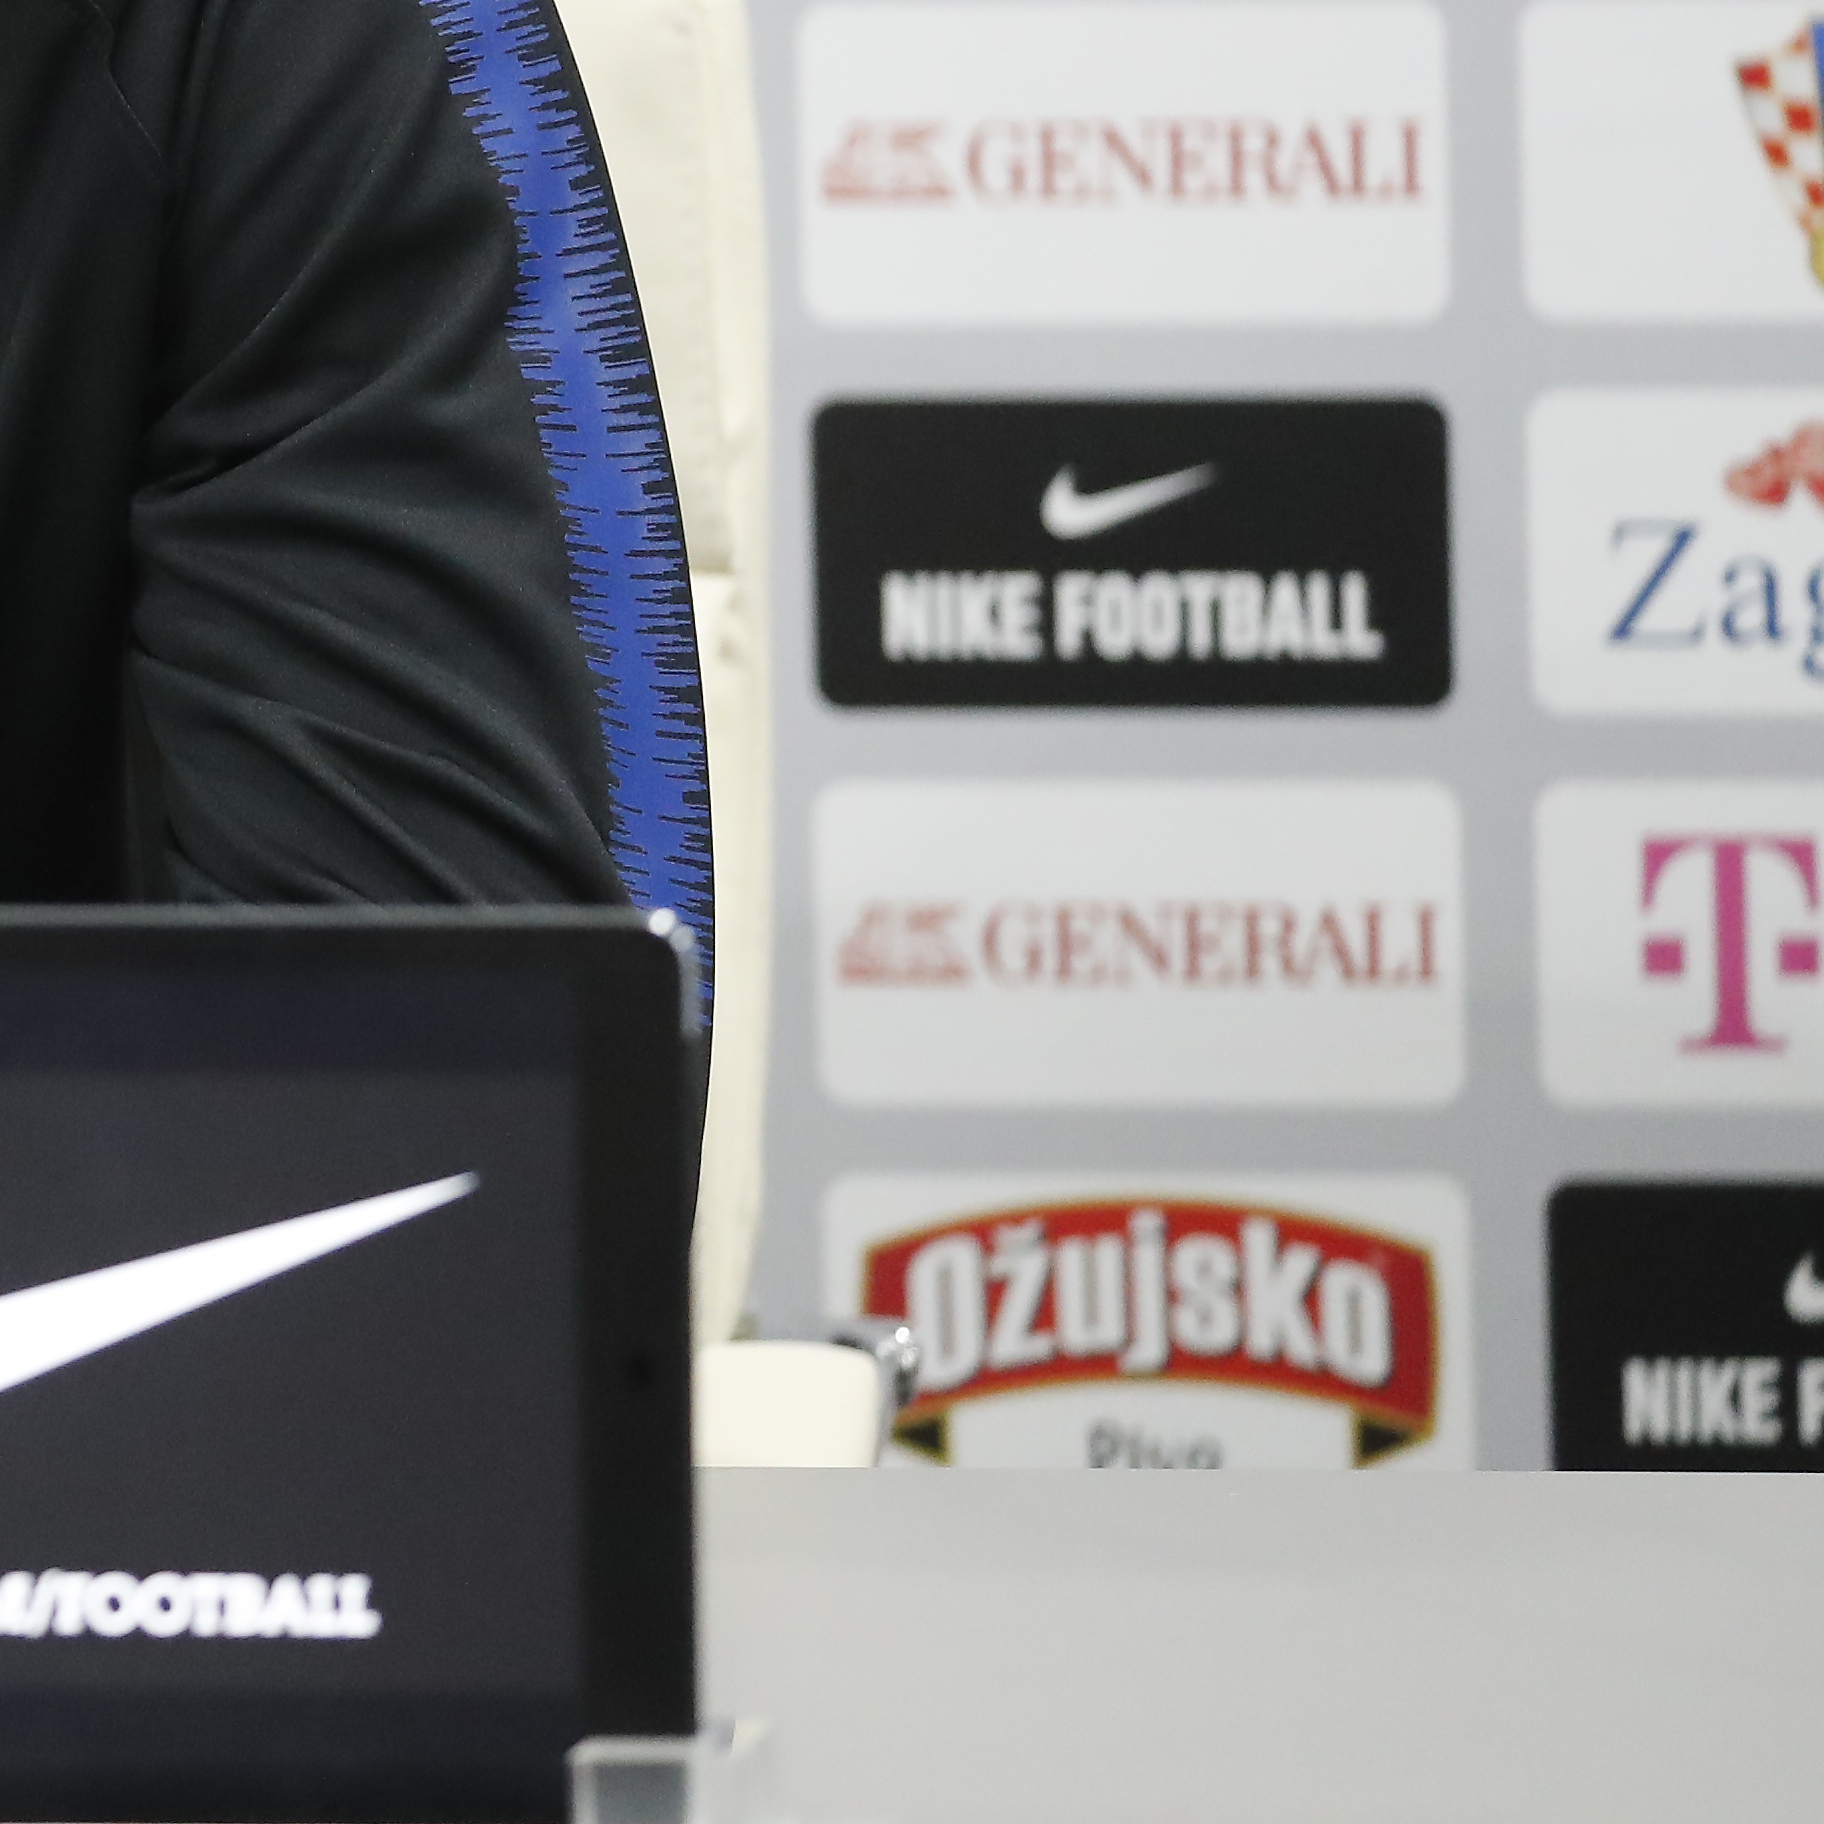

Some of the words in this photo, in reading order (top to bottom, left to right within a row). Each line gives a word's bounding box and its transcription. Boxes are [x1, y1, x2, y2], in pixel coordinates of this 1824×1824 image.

[966, 120, 1423, 203] GENERALI
[882, 572, 1042, 660] NIKE
[1054, 572, 1384, 660] FOOTBALL
[982, 905, 1438, 988] GENERALI
[906, 1208, 1394, 1392] Ožujsko
[1622, 1357, 1783, 1446] NIKE
